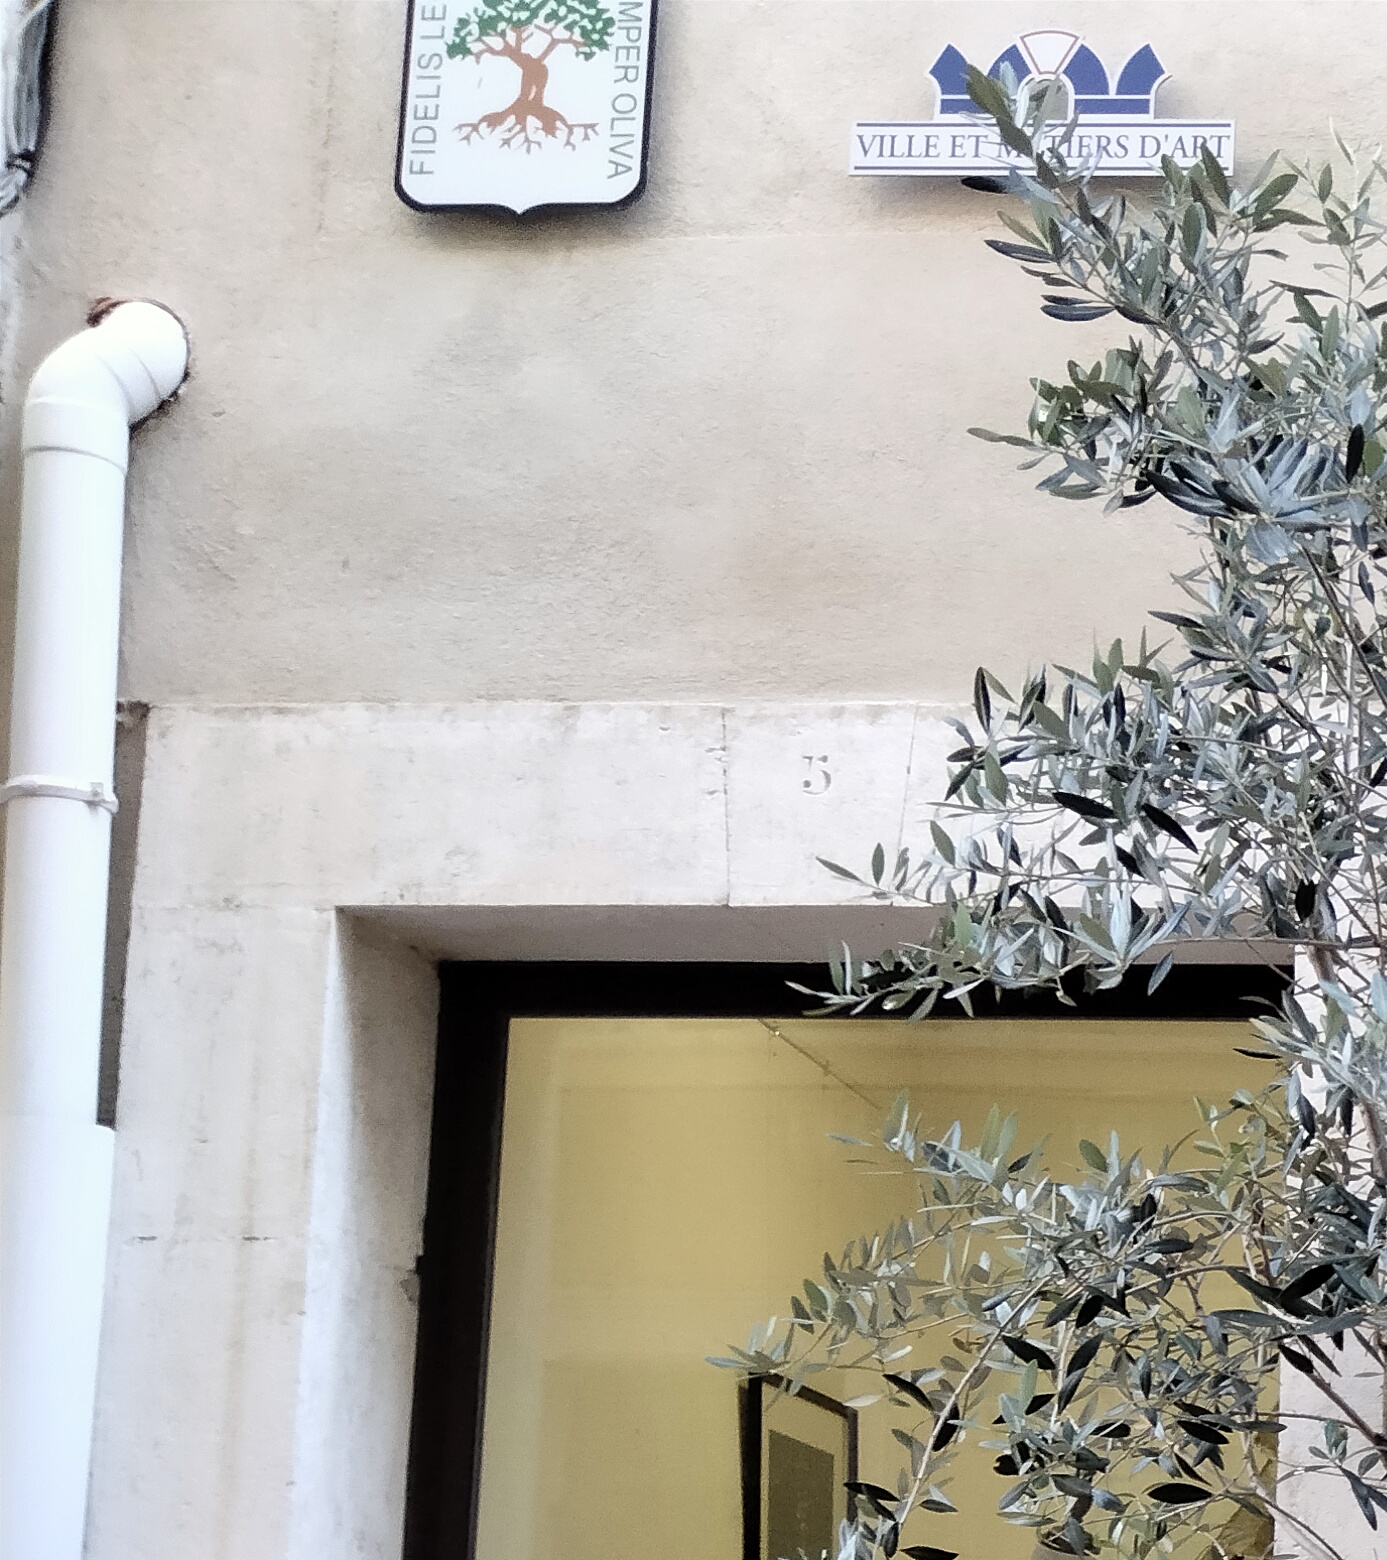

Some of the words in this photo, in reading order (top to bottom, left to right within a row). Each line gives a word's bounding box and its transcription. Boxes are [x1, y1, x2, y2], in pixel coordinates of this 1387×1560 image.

[409, 53, 443, 175] FIDELIS
[607, 93, 638, 180] OLIVA
[856, 134, 941, 158] VILLE
[949, 134, 989, 158] ET
[997, 133, 1130, 159] MTIERS
[1139, 133, 1231, 159] D'ART
